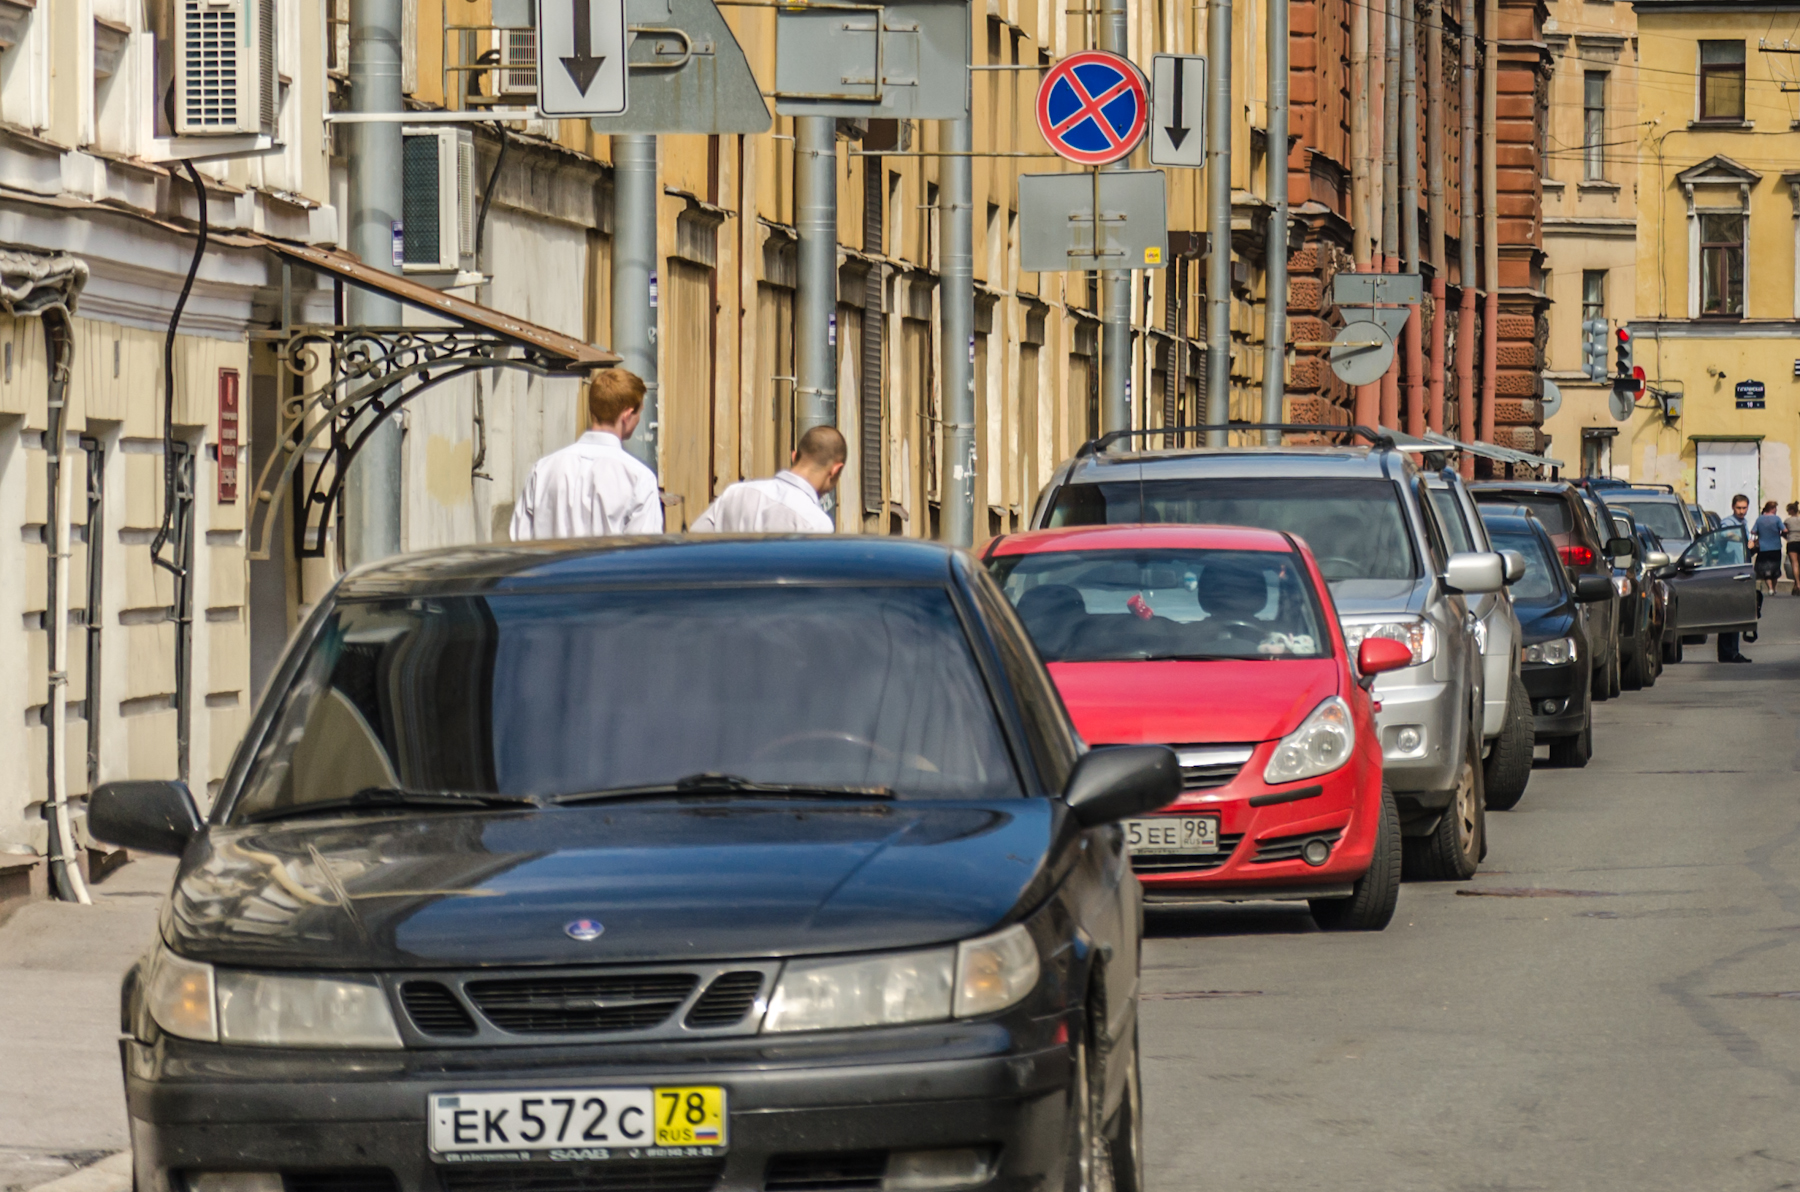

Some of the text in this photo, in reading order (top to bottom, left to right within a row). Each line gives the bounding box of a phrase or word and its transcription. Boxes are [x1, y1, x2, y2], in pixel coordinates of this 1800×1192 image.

[1184, 820, 1208, 838] 98
[660, 1092, 706, 1126] 78
[659, 1128, 693, 1142] RUS
[548, 1148, 610, 1161] SAAB
